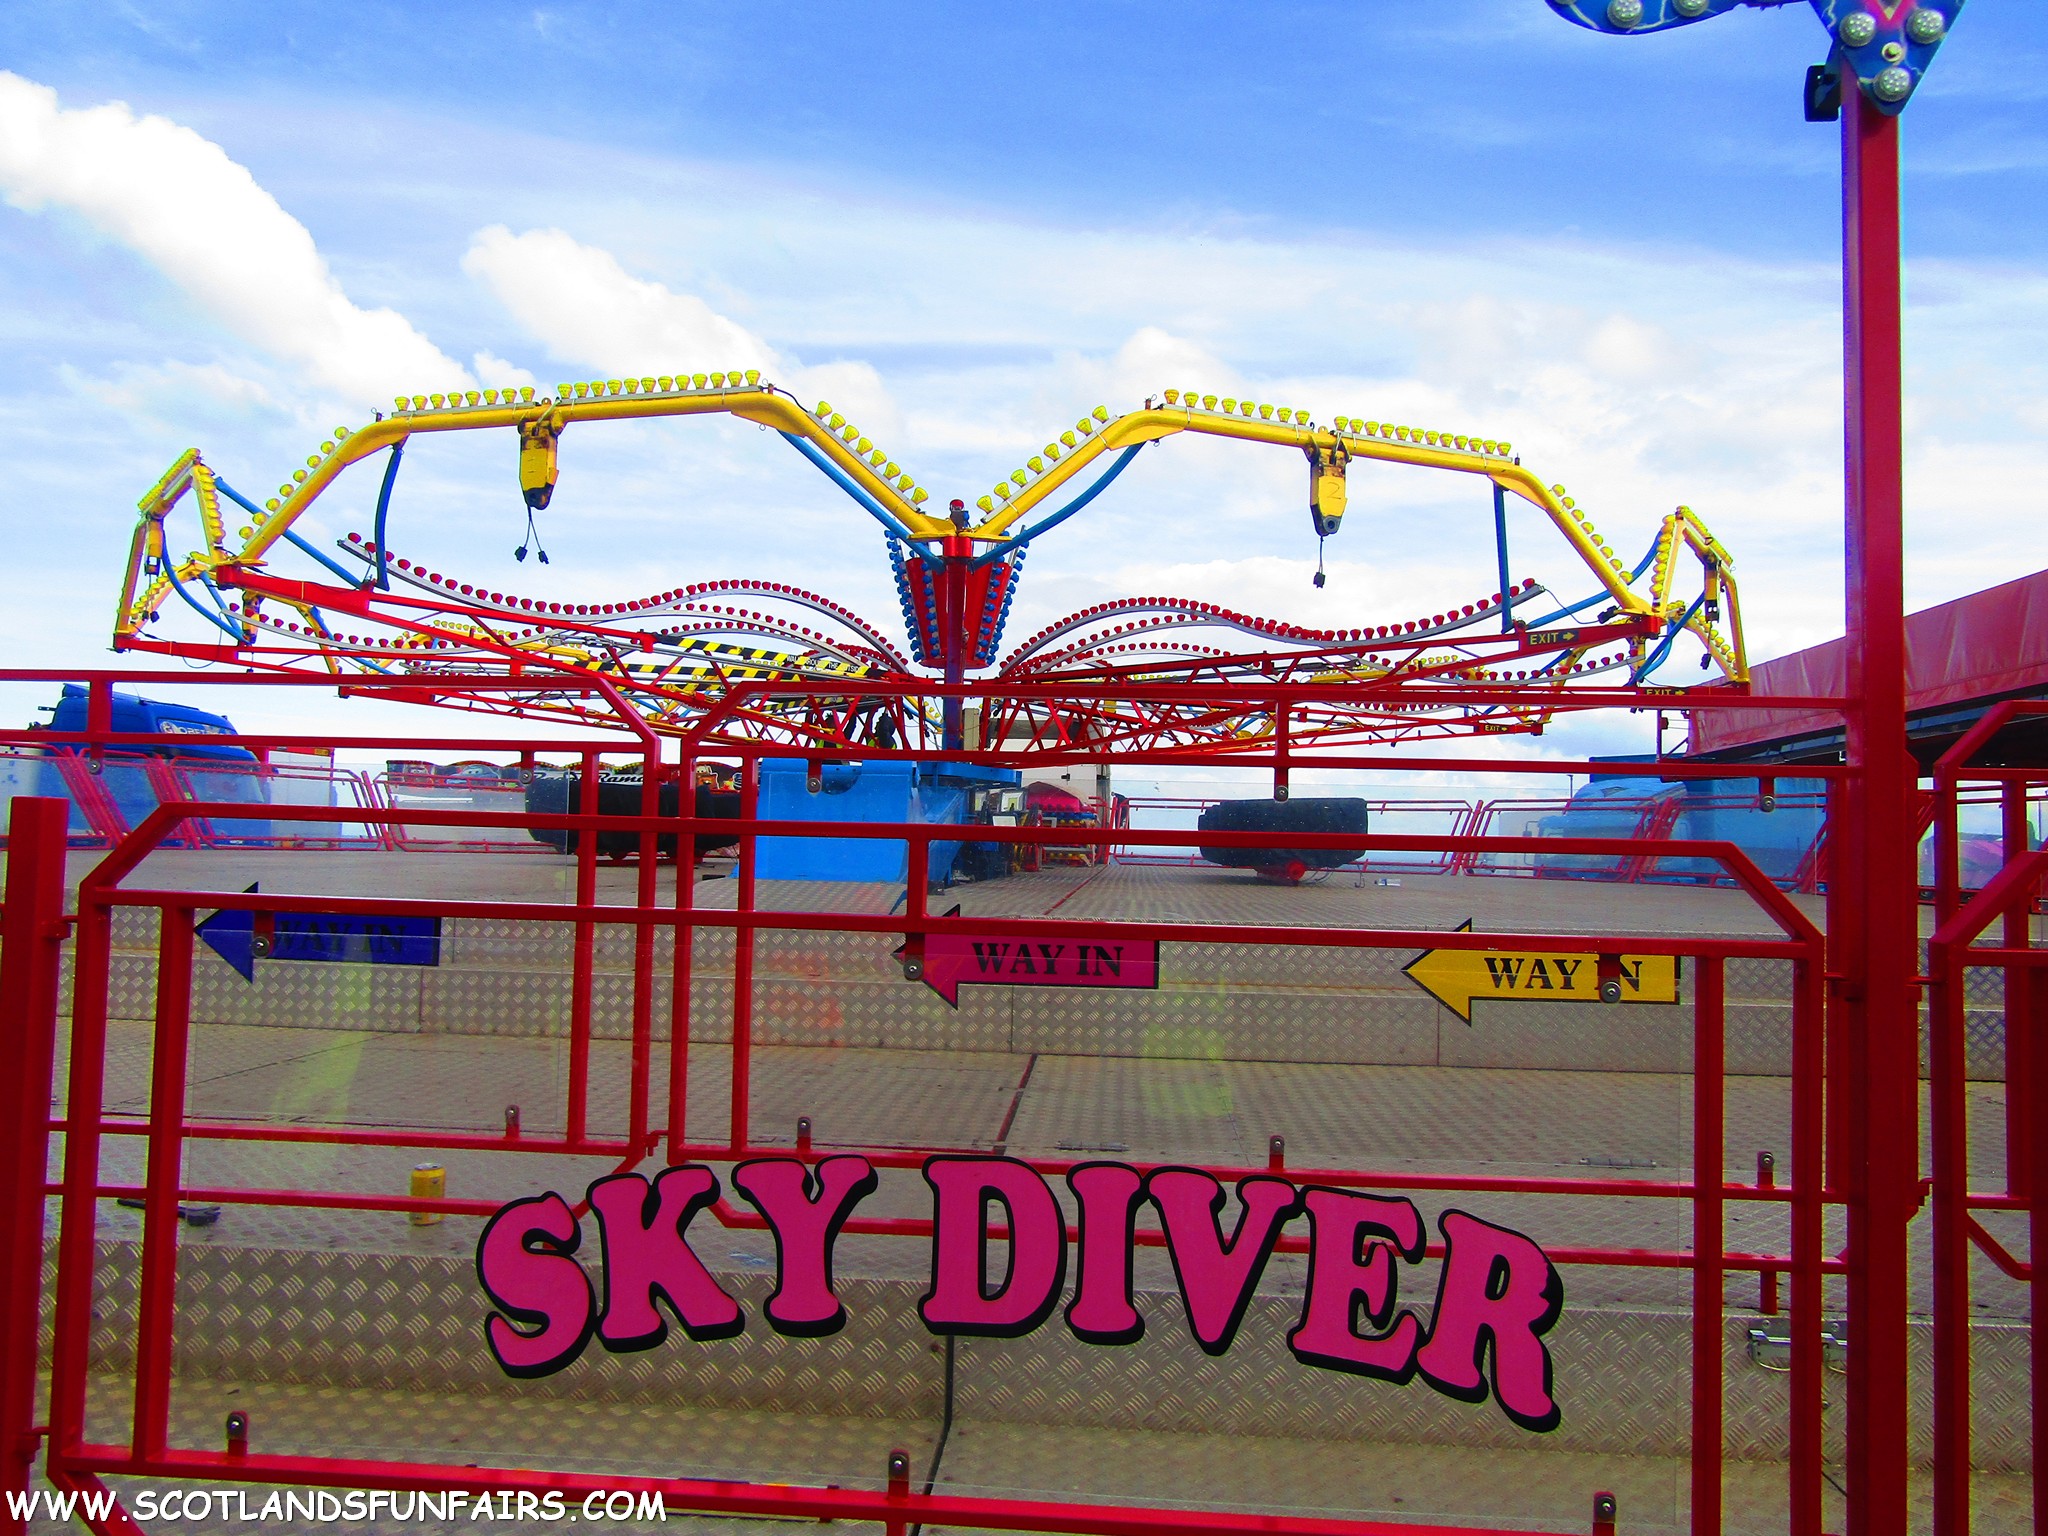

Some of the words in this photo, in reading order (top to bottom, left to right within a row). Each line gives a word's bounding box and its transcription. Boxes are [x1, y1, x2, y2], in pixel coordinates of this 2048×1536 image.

[1529, 632, 1559, 645] EXIT
[1484, 724, 1500, 732] EXIT
[272, 920, 353, 952] WAY
[361, 923, 407, 953] IN
[972, 942, 1066, 976] WAY
[1076, 945, 1124, 977] IN
[1484, 957, 1583, 991] WAY
[1594, 960, 1643, 993] N
[476, 1154, 878, 1379] SKY
[918, 1154, 1565, 1433] DIVER
